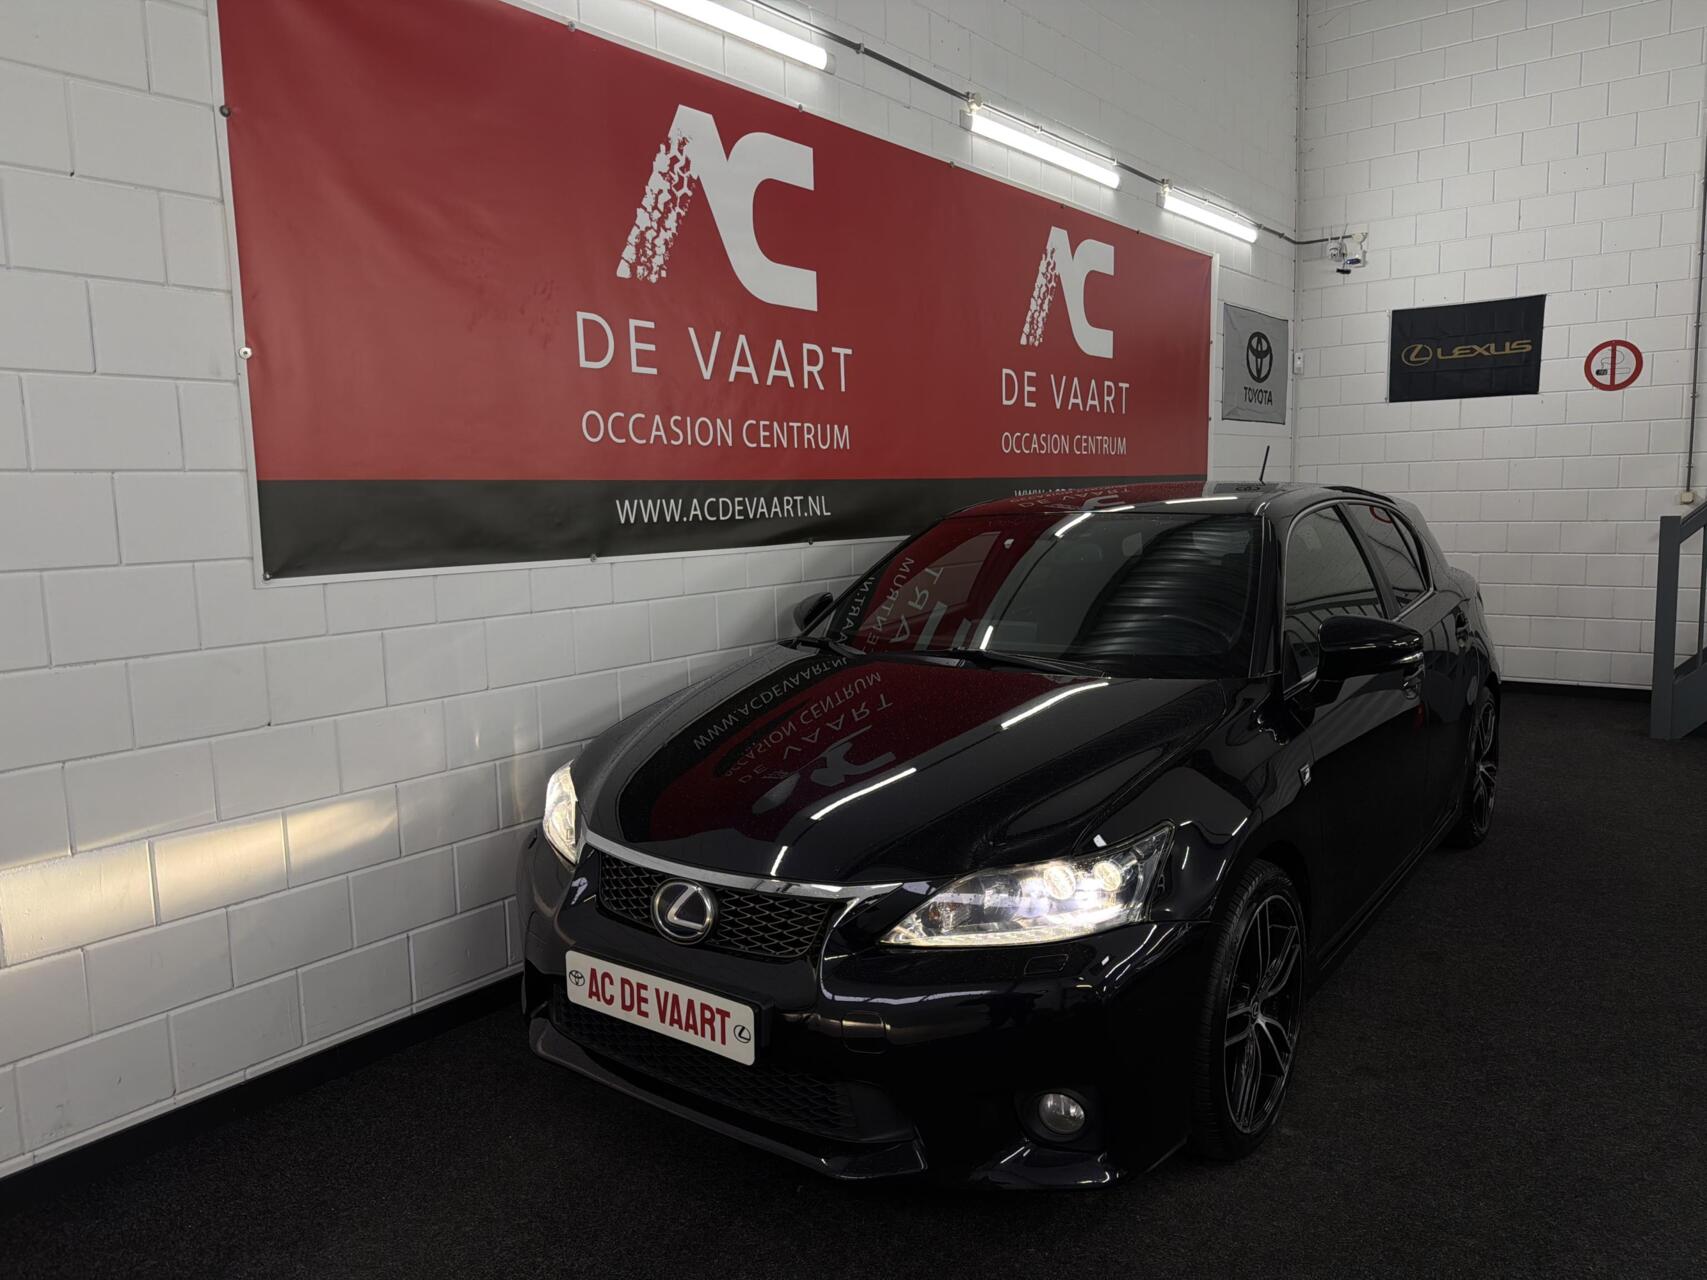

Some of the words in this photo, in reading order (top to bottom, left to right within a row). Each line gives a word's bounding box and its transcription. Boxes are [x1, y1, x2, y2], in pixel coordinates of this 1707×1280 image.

[616, 104, 818, 312] AC
[1019, 226, 1114, 359] AC
[576, 311, 658, 375] DE
[687, 326, 853, 392] VAART
[1437, 339, 1533, 360] LEXUS
[1001, 368, 1037, 408] DE
[1050, 374, 1130, 414] VAART
[1243, 386, 1273, 406] TOYOTA
[581, 410, 733, 447] OCCASION
[742, 420, 851, 450] CENTRUM
[1001, 432, 1070, 454] OCCASION
[1073, 435, 1127, 456] CENTRUM
[615, 495, 831, 525] WWW.ACDEVAART.NL
[588, 967, 615, 1006] AC
[620, 977, 649, 1018] DE
[655, 987, 731, 1046] VAART
